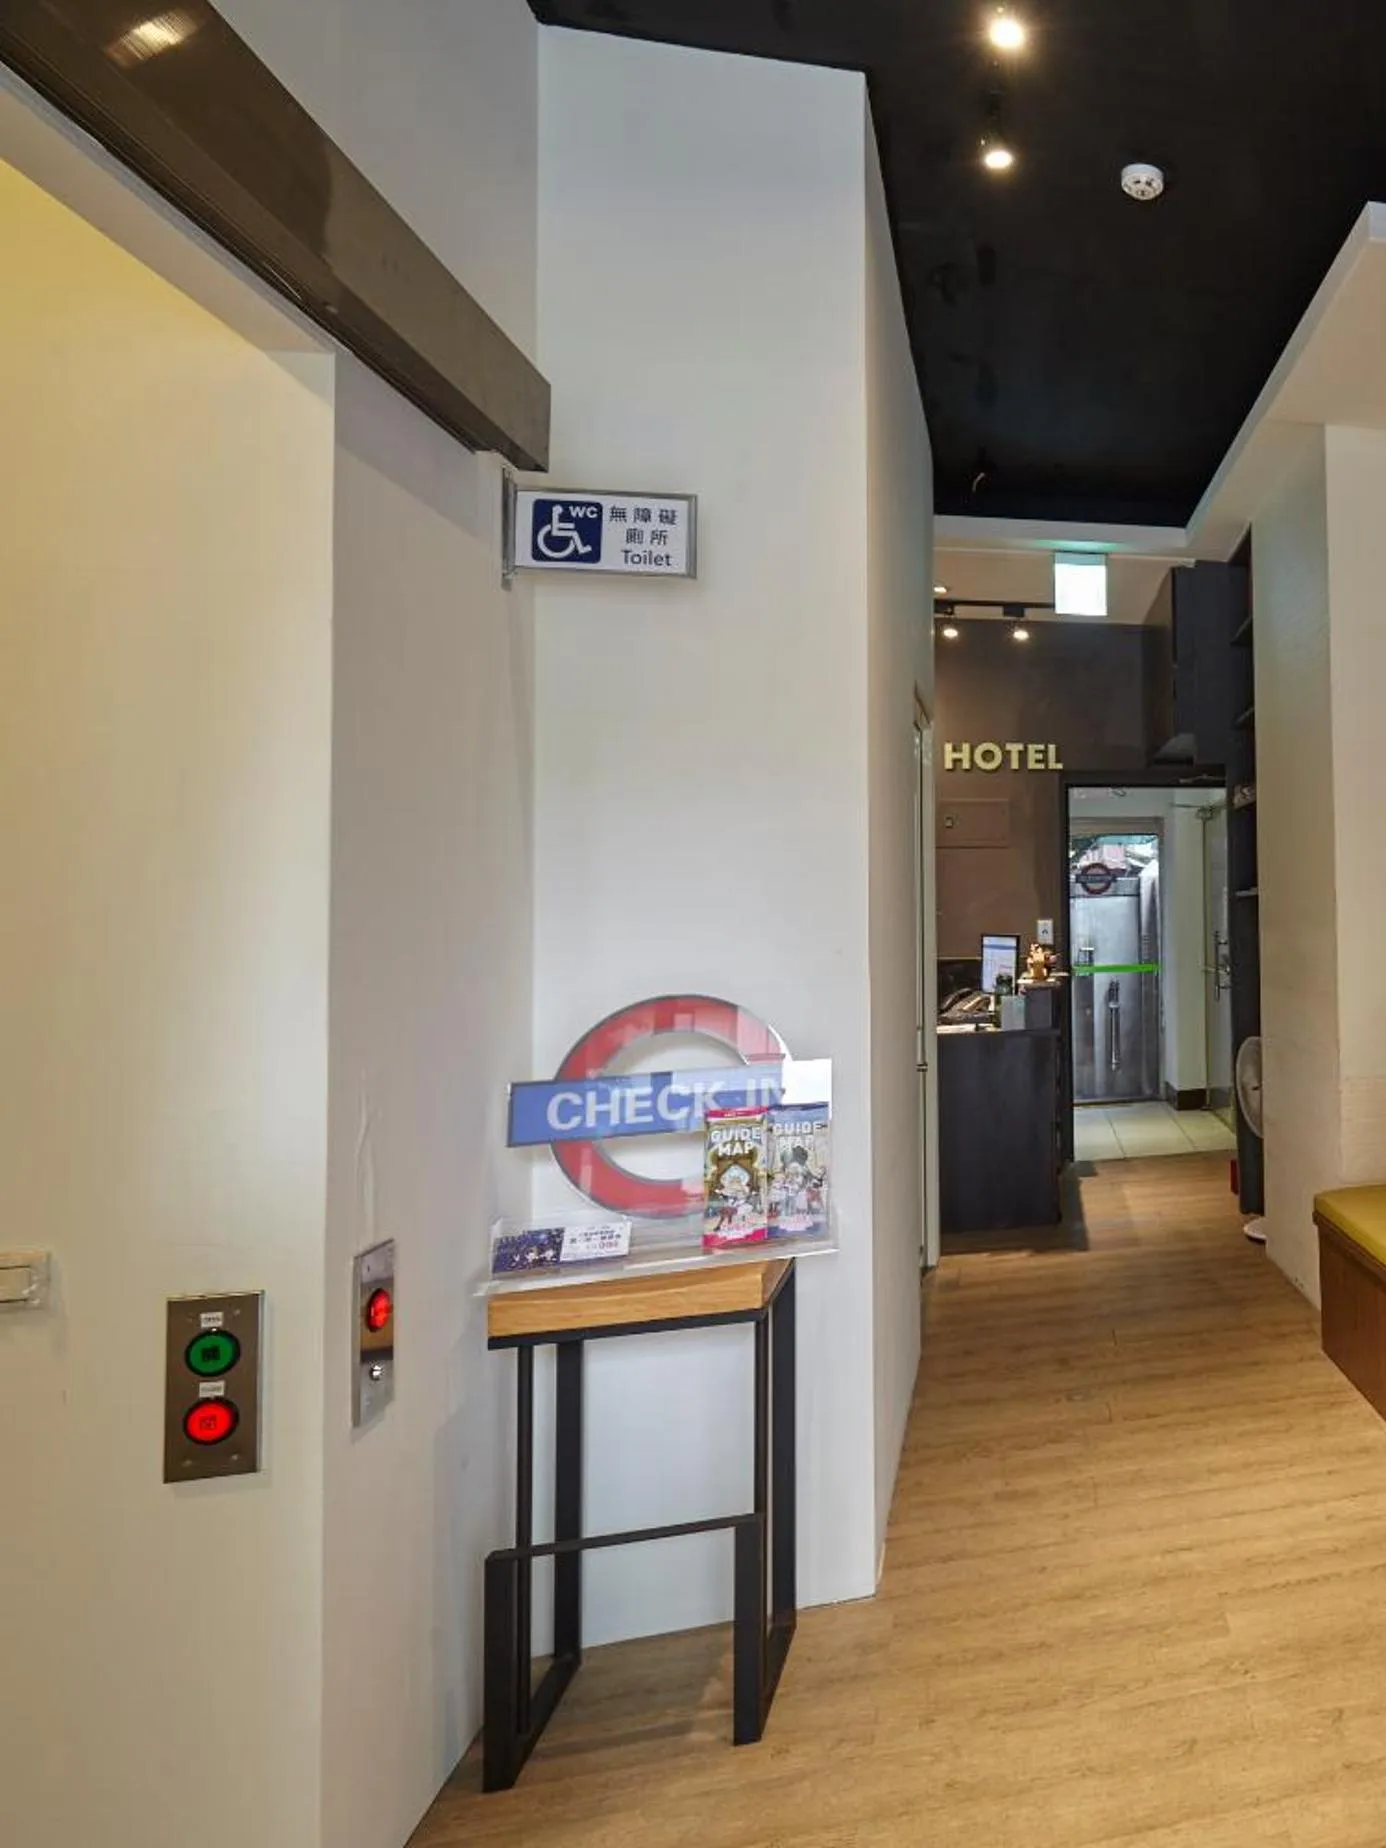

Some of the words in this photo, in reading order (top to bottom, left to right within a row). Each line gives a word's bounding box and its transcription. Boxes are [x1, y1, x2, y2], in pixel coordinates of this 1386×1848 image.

[569, 505, 599, 518] WC
[608, 505, 678, 526] 無障礙
[625, 527, 668, 546] 廁所
[621, 549, 673, 567] Toilet
[943, 741, 1064, 772] HOTEL
[547, 1081, 726, 1132] CHECK
[710, 1125, 762, 1143] GUIDE
[718, 1140, 754, 1157] MAP
